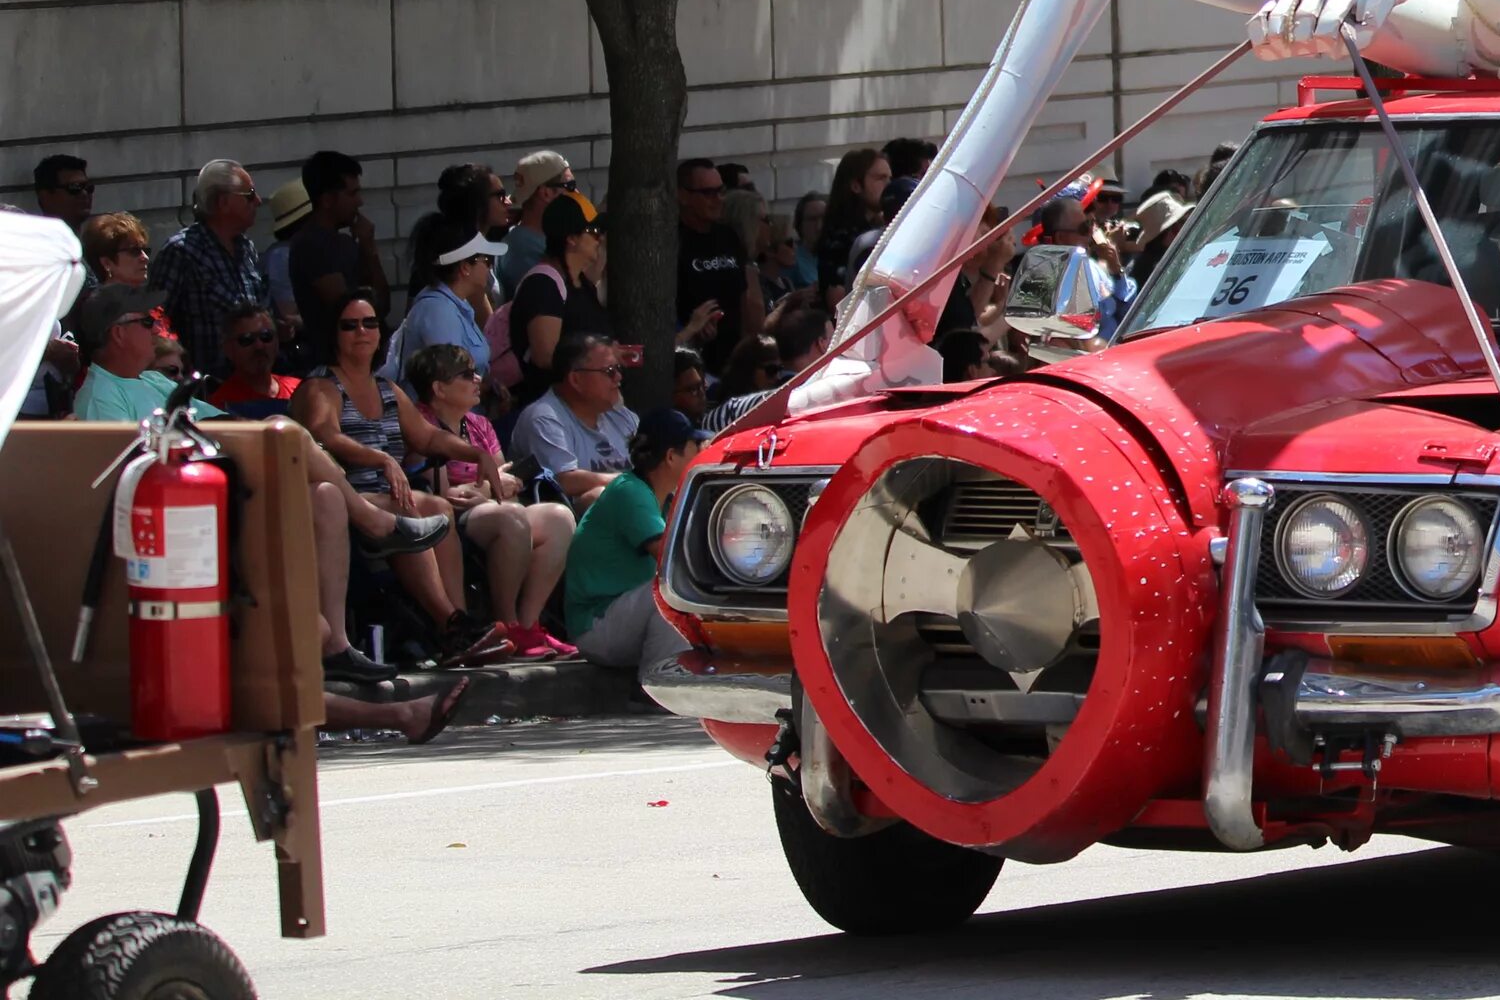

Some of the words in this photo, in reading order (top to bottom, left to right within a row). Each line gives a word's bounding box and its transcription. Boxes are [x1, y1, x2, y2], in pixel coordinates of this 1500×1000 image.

[1227, 252, 1267, 266] HOUSTON
[1264, 251, 1287, 265] ART
[1210, 275, 1258, 307] 36
